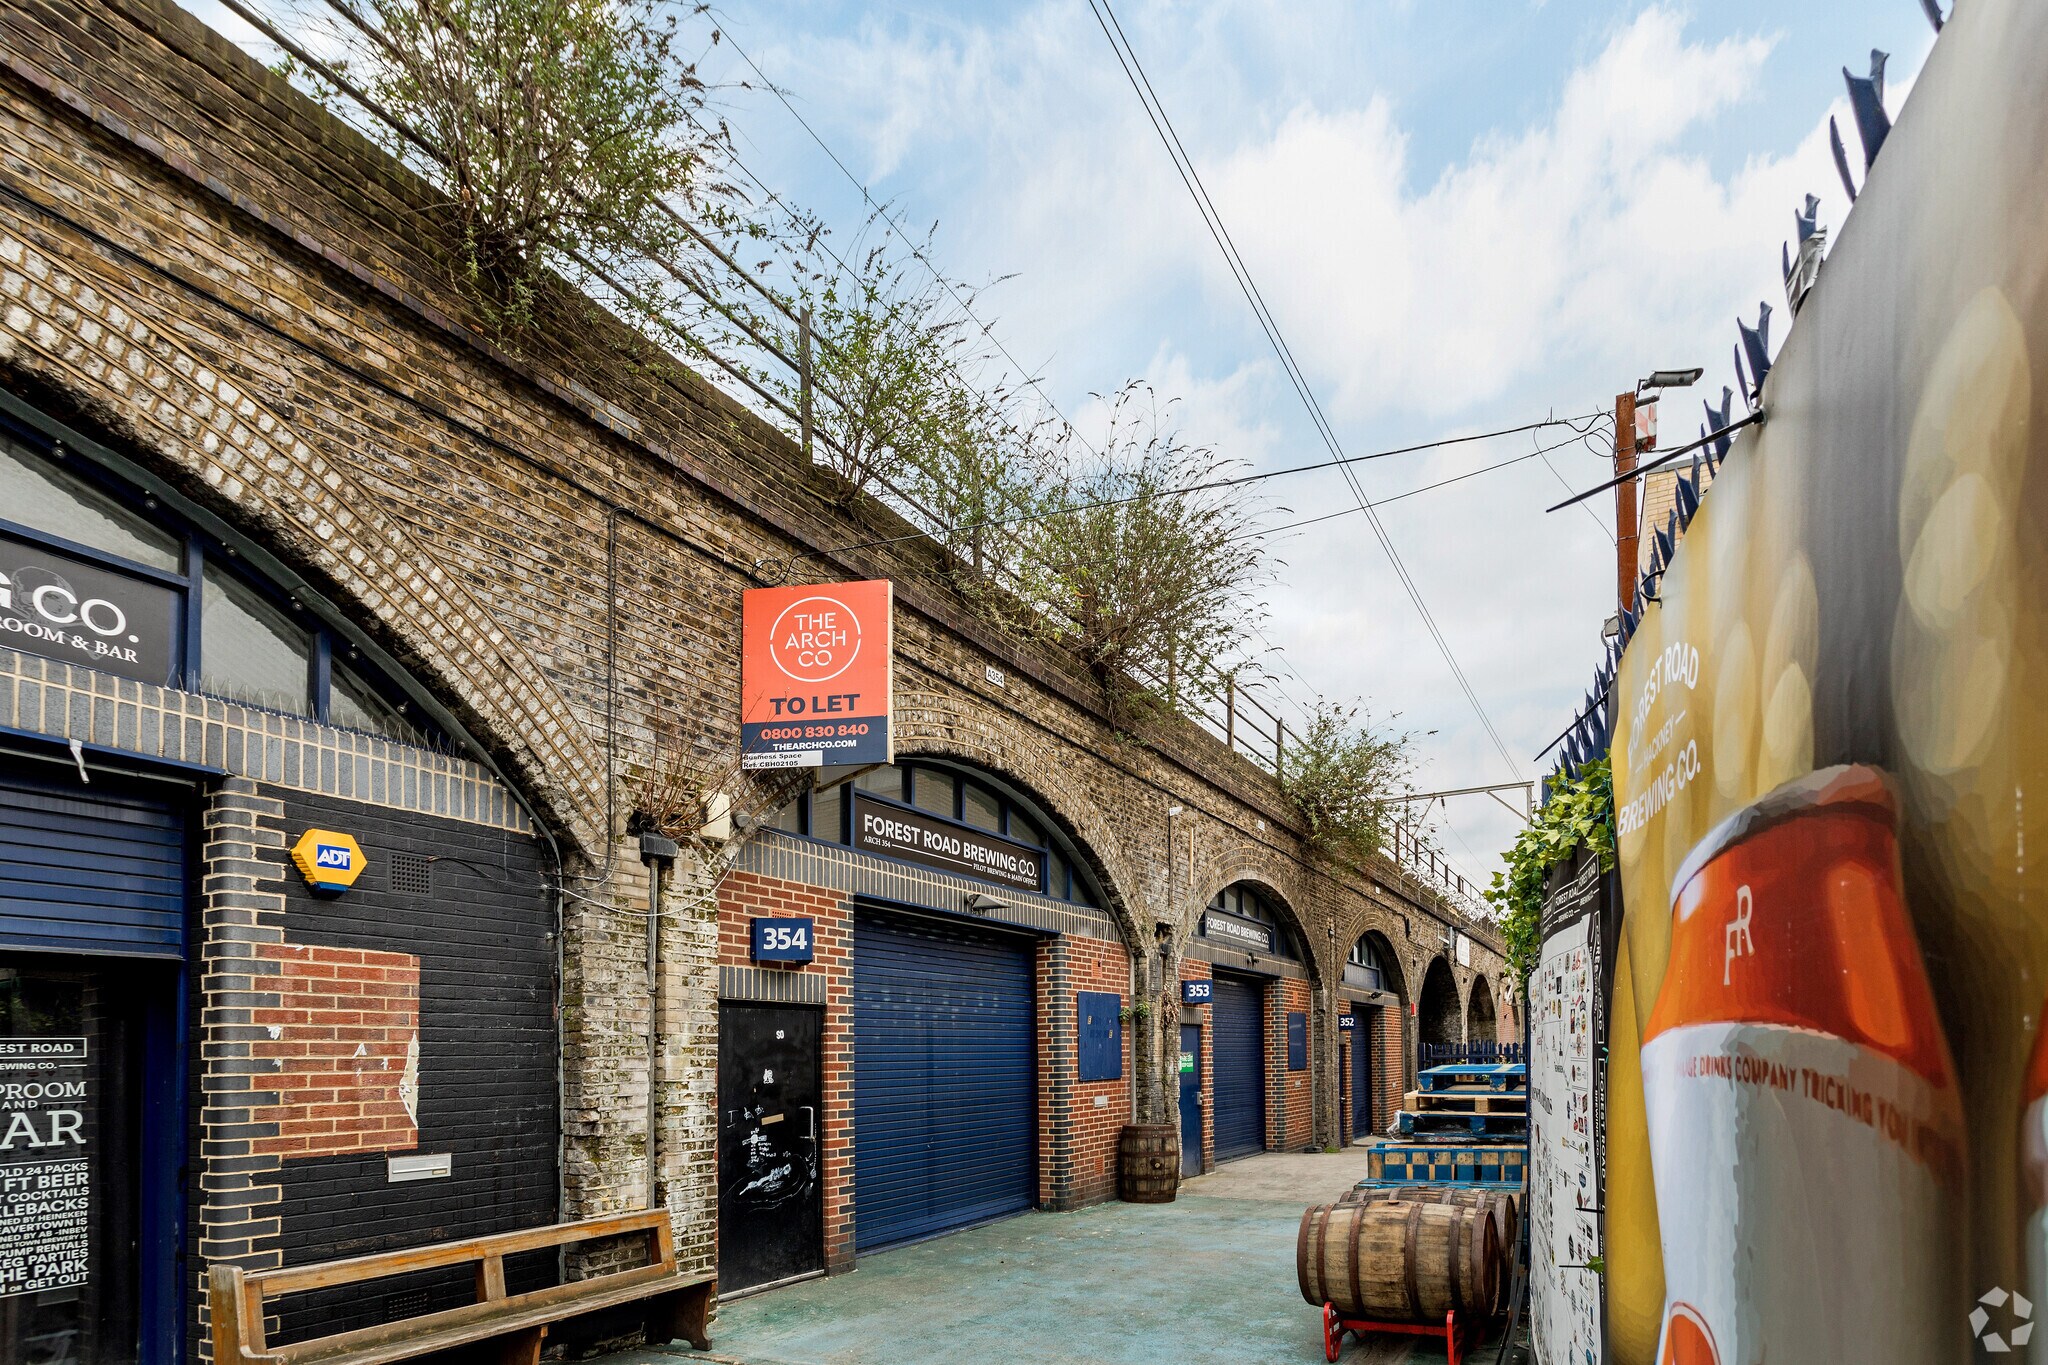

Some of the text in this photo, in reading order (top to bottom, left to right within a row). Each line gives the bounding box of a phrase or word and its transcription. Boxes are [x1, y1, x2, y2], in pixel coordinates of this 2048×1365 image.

[32, 585, 140, 643] CO.
[794, 612, 836, 630] THE
[785, 630, 846, 650] ARCH
[71, 636, 89, 650] &
[94, 640, 139, 664] BAR
[798, 650, 832, 667] CO
[770, 693, 860, 716] TO LET
[1628, 642, 1700, 768] FOREST ROAD
[760, 723, 869, 740] 0800 830 840
[772, 740, 856, 751] THEARCHCO.COM
[1644, 714, 1675, 770] HACKNEY
[1618, 738, 1700, 838] BREWING CO.
[864, 835, 891, 848] ARCH 354
[864, 813, 1037, 878] FOREST ROAD BREWING CO.
[317, 849, 350, 866] ADT
[973, 863, 987, 872] PILOT
[987, 867, 1007, 878] BREWING
[1207, 917, 1226, 932] FOREST
[1227, 922, 1240, 935] ROAD
[1241, 926, 1261, 941] BREWING
[763, 928, 807, 950] 354
[1188, 984, 1210, 997] 353
[1340, 1017, 1354, 1027] 352
[30, 1044, 74, 1053] ROAD
[37, 1062, 57, 1070] CO.
[1735, 1056, 1796, 1092] COMPANY
[1, 1100, 38, 1110] AND
[26, 1167, 42, 1176] 24
[45, 1162, 89, 1174] PACKS
[4, 1172, 89, 1192] FT BEER
[7, 1186, 90, 1203] COCKTAILS
[23, 1216, 36, 1224] BY
[38, 1210, 87, 1221] HEINEKEN
[23, 1232, 37, 1240] BY
[42, 1234, 79, 1244] BREWERY
[36, 1240, 89, 1253] RENTALS
[0, 1248, 89, 1269] EG PARTIES
[34, 1258, 88, 1278] PARK
[25, 1277, 56, 1289] GET
[58, 1271, 89, 1284] OUT
